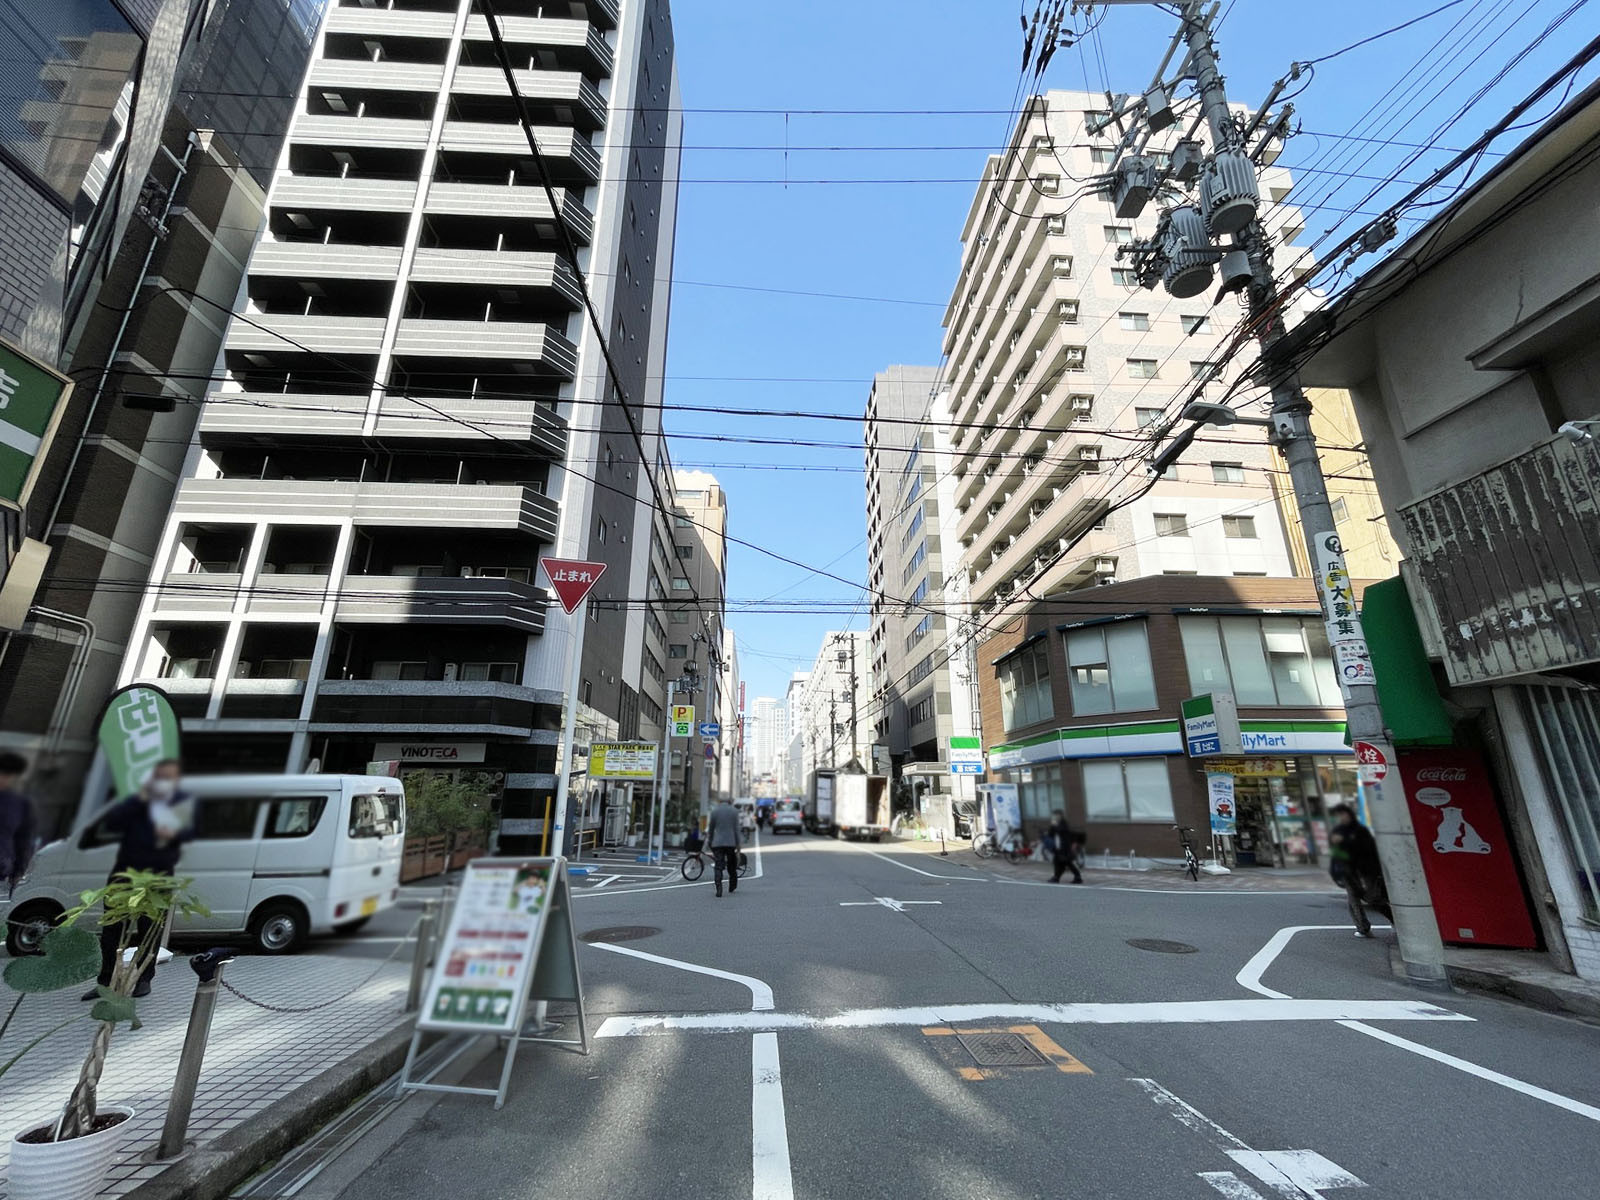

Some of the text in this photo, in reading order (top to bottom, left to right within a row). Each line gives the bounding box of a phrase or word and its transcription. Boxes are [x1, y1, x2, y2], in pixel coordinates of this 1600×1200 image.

[552, 569, 593, 583] 止まれ
[1328, 561, 1355, 635] 広告大募集
[678, 707, 687, 718] P
[1187, 720, 1216, 732] FamilyMart
[1240, 733, 1287, 750] ilyMart
[401, 746, 458, 759] VINOTECA
[1416, 767, 1467, 782] Coca-Cola
